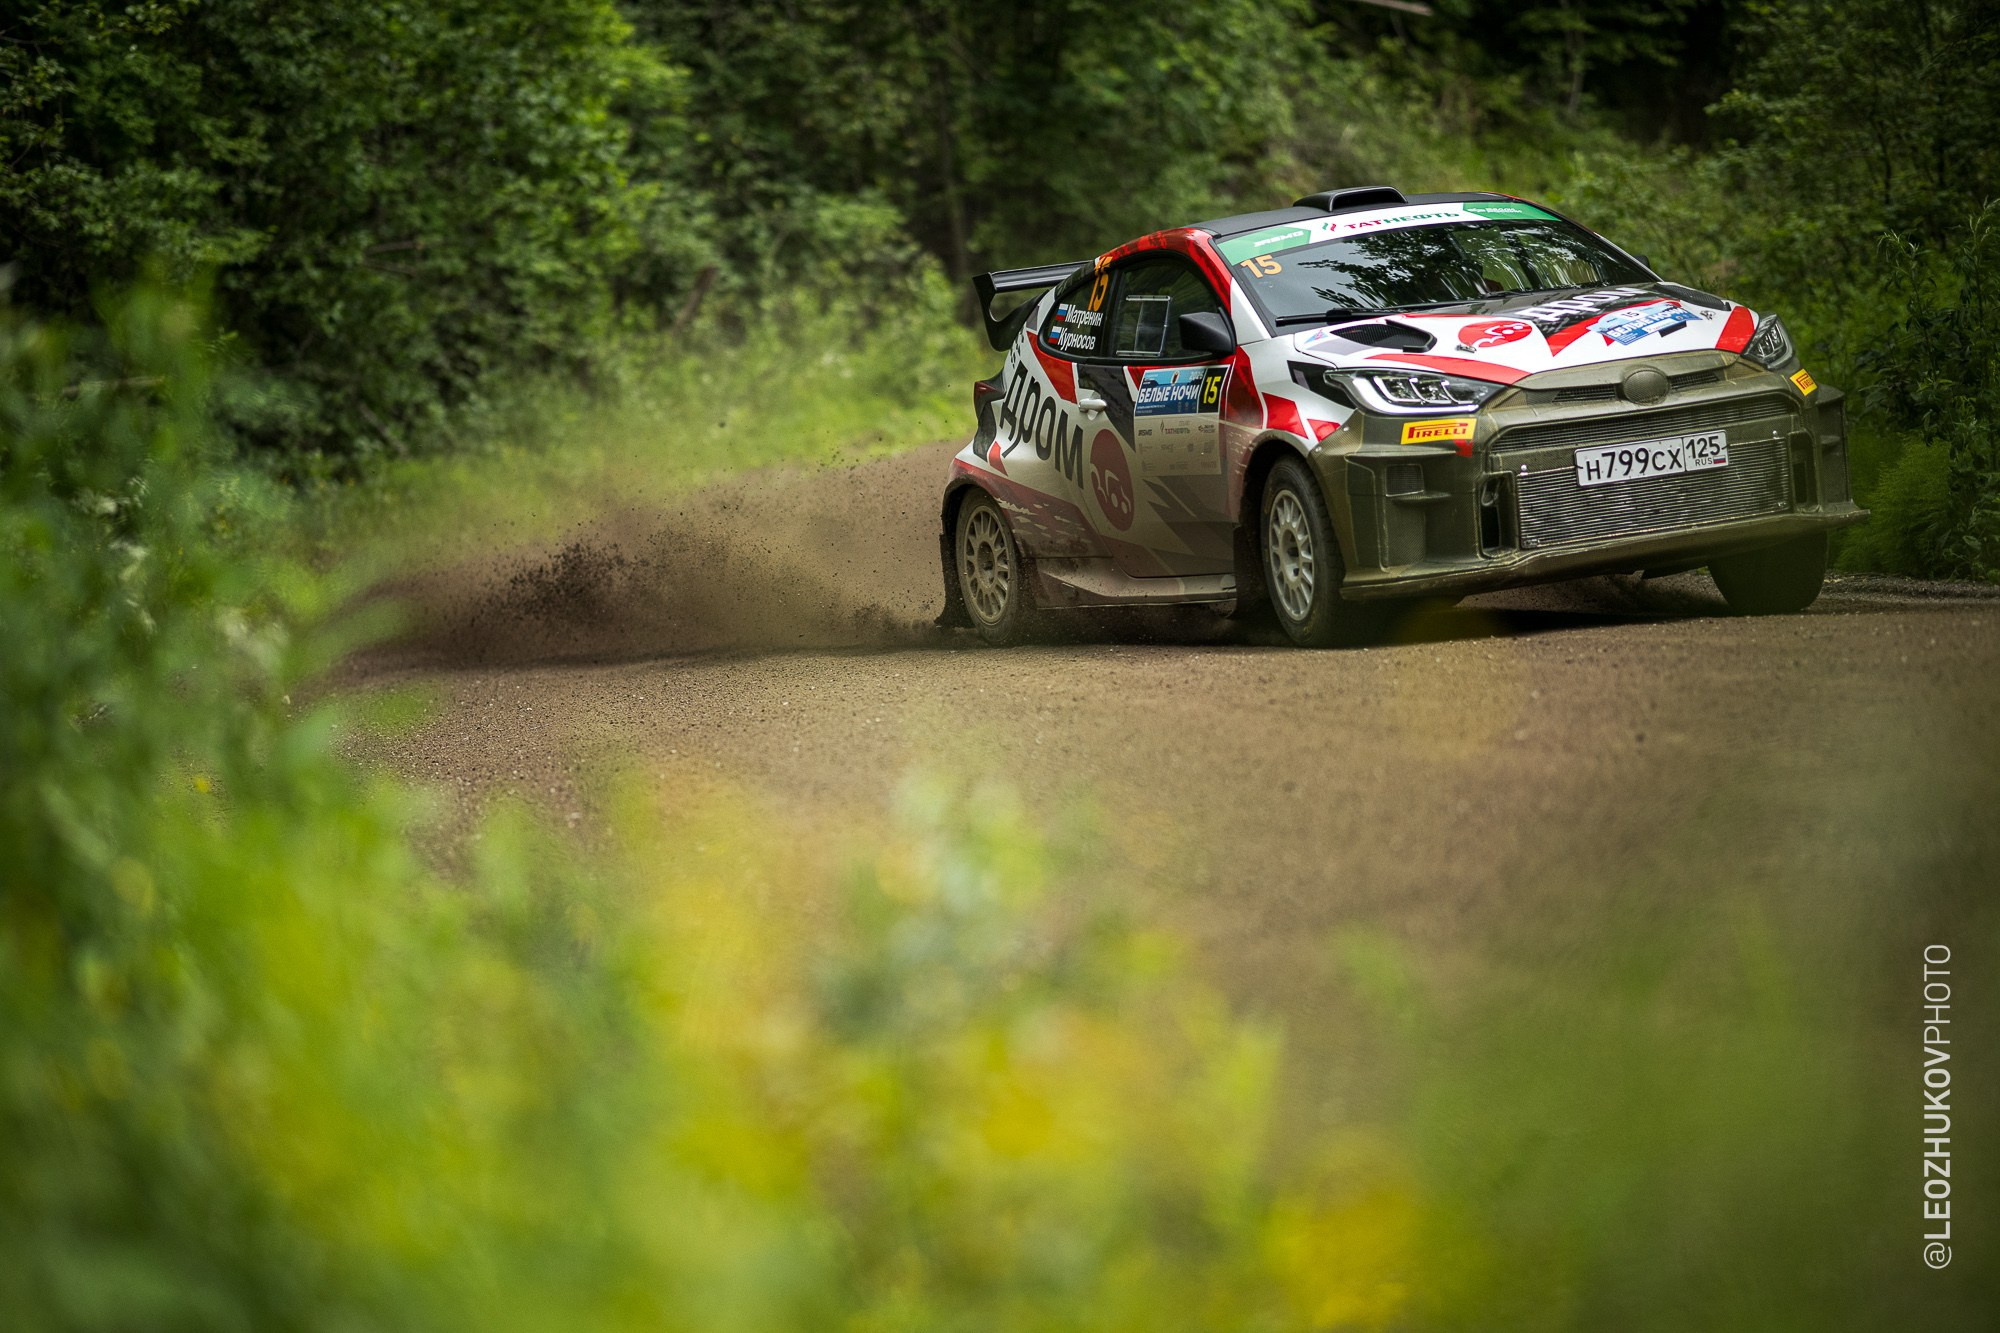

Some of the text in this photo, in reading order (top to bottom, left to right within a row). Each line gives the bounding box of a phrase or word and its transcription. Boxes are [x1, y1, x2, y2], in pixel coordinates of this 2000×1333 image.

[1344, 212, 1460, 230] ТАТНЕФТЬ
[1240, 254, 1282, 278] 15
[1088, 256, 1113, 312] 15
[1064, 304, 1104, 328] Матренин
[1606, 315, 1654, 338] БЕЛЫЕ
[1057, 327, 1096, 351] Курносов
[1138, 385, 1200, 403] БЕЛЫЕ НОЧИ
[1203, 376, 1221, 404] 15
[1408, 423, 1469, 439] PIRELLI
[1586, 435, 1720, 481] Н799СХ 125
[1695, 457, 1713, 466] RUS
